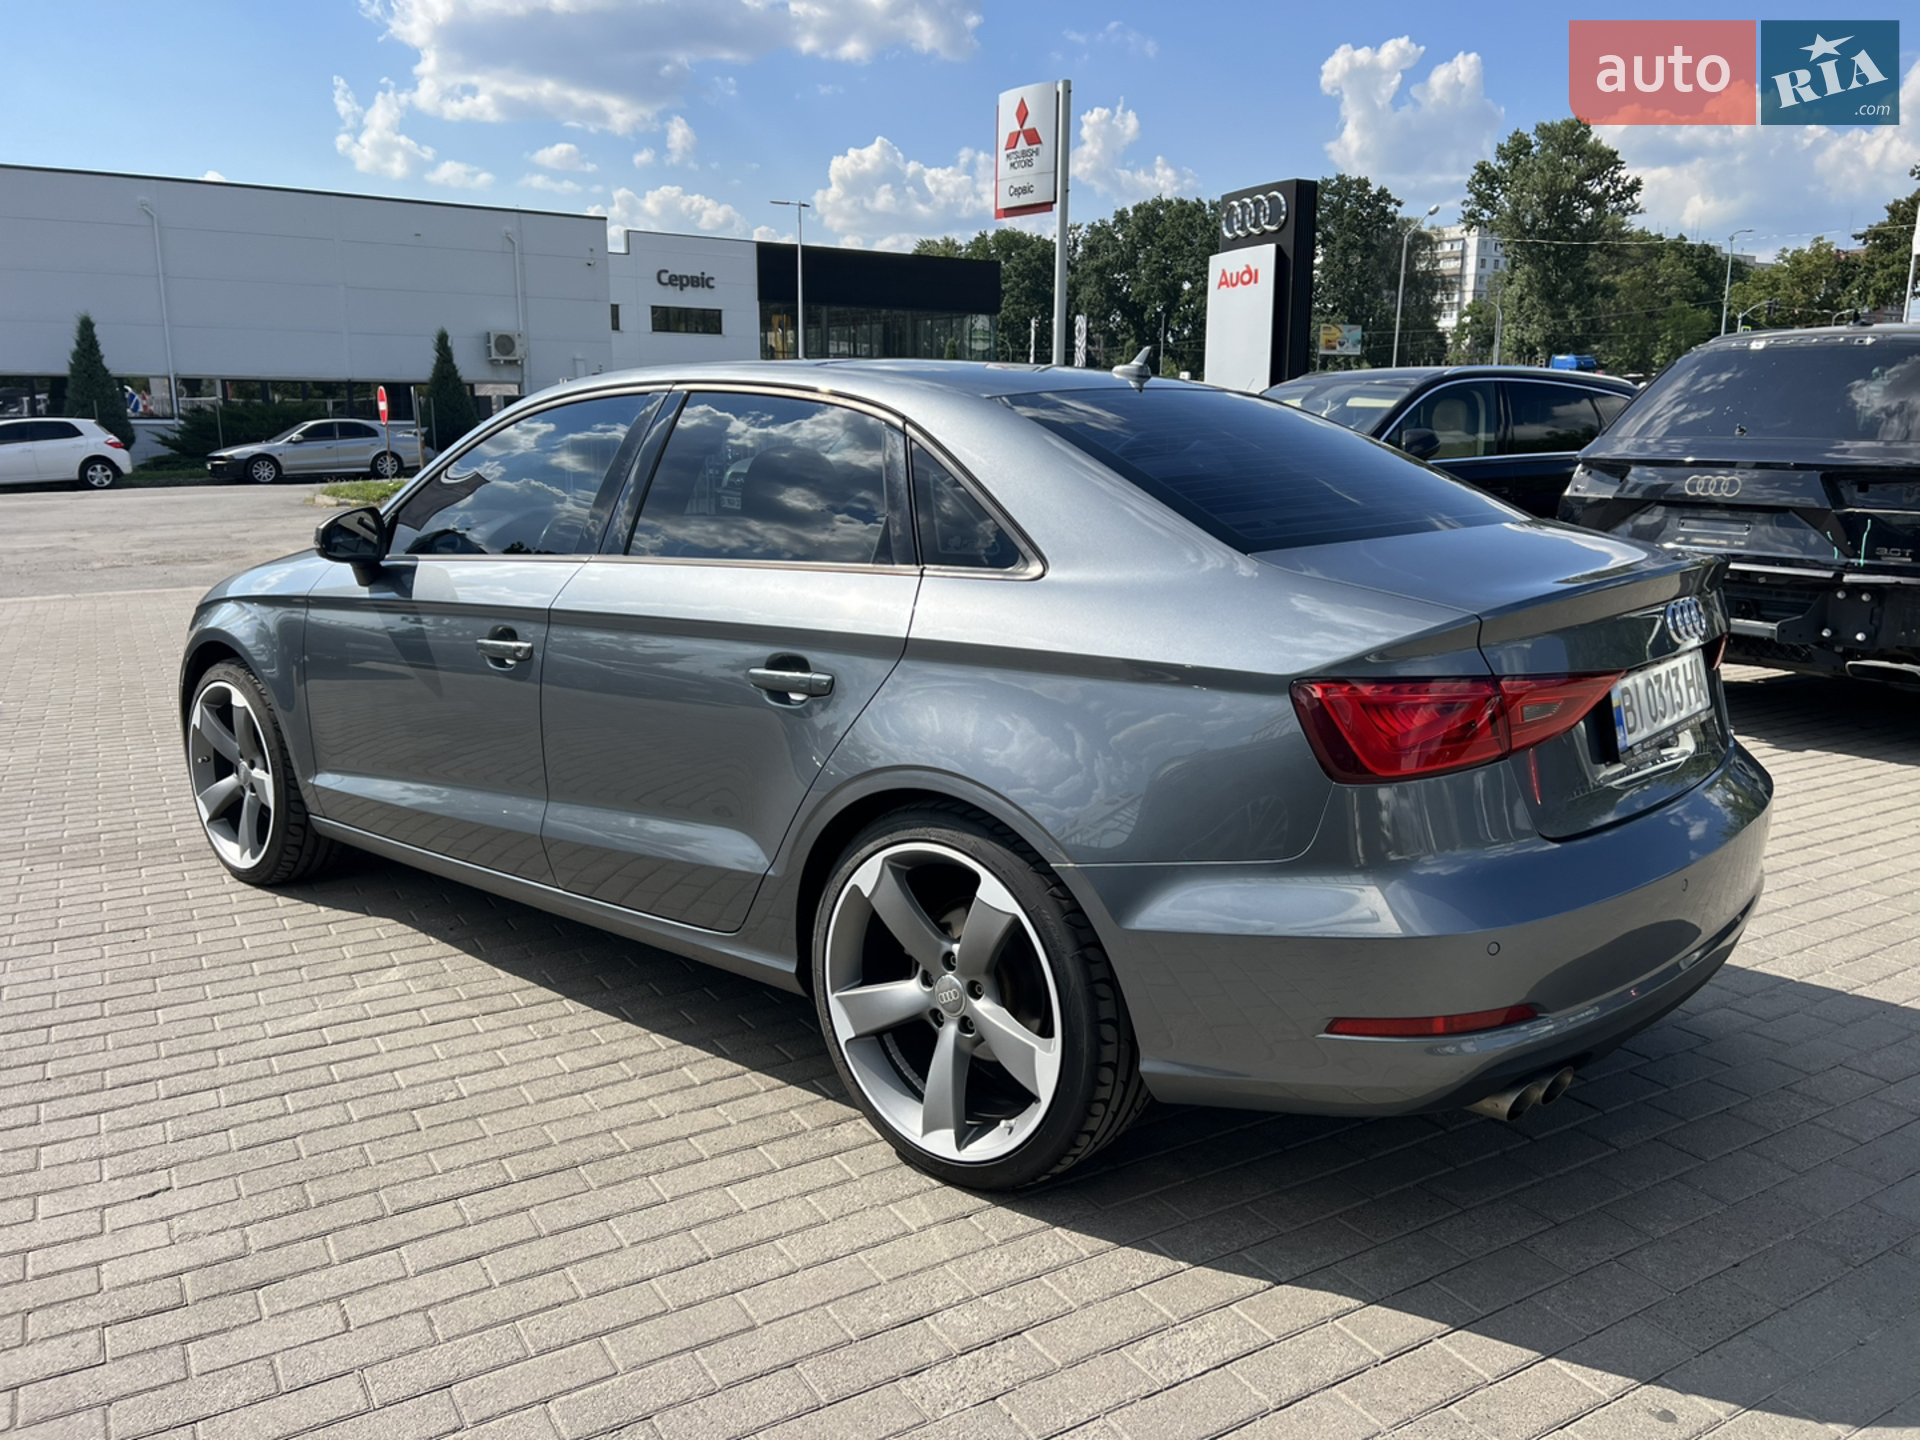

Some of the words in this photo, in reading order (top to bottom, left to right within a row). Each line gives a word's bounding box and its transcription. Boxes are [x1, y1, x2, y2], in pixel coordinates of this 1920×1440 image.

[1006, 147, 1040, 161] MITSUBISHI
[1009, 158, 1034, 170] MOTORS
[1008, 182, 1035, 198] Сервіс
[656, 269, 715, 291] Сервіс
[1217, 264, 1259, 290] Audi
[1645, 666, 1685, 723] 0313
